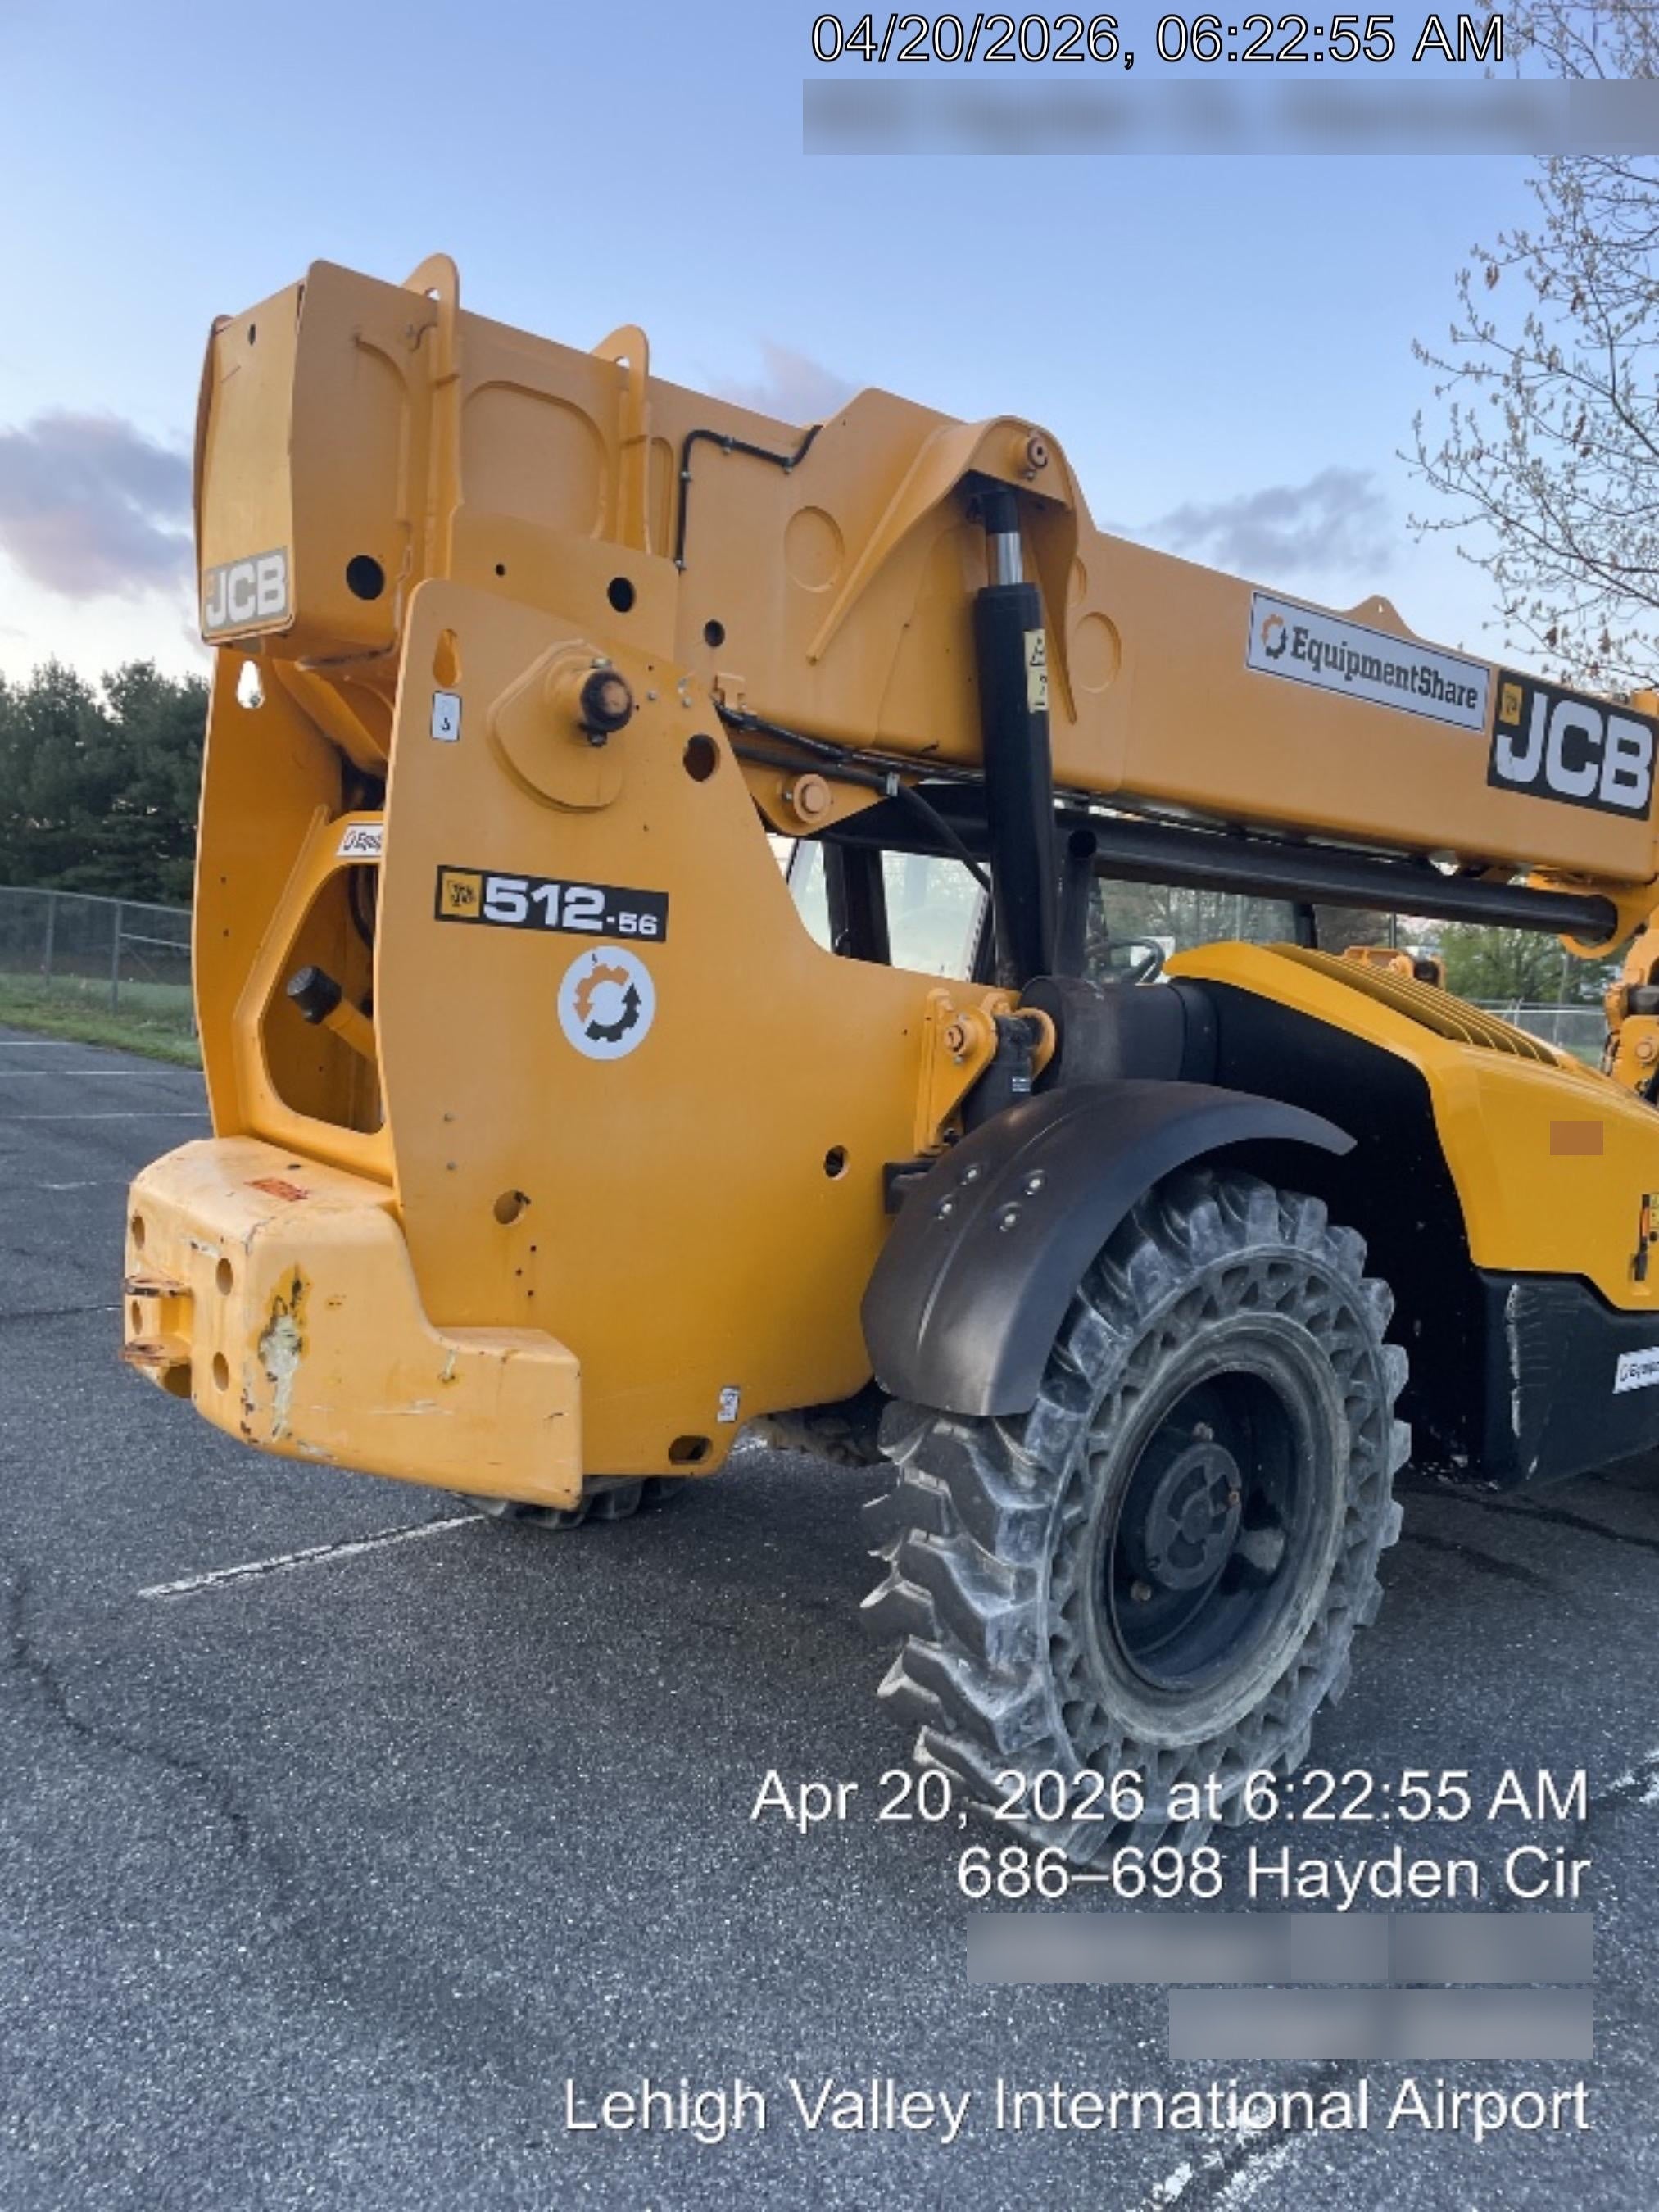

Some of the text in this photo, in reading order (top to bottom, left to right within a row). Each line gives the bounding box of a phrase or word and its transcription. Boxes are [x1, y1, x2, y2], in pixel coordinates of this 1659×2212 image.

[206, 555, 286, 628] JCB
[1289, 625, 1479, 709] EquipmentShare
[1495, 691, 1653, 809] JCB
